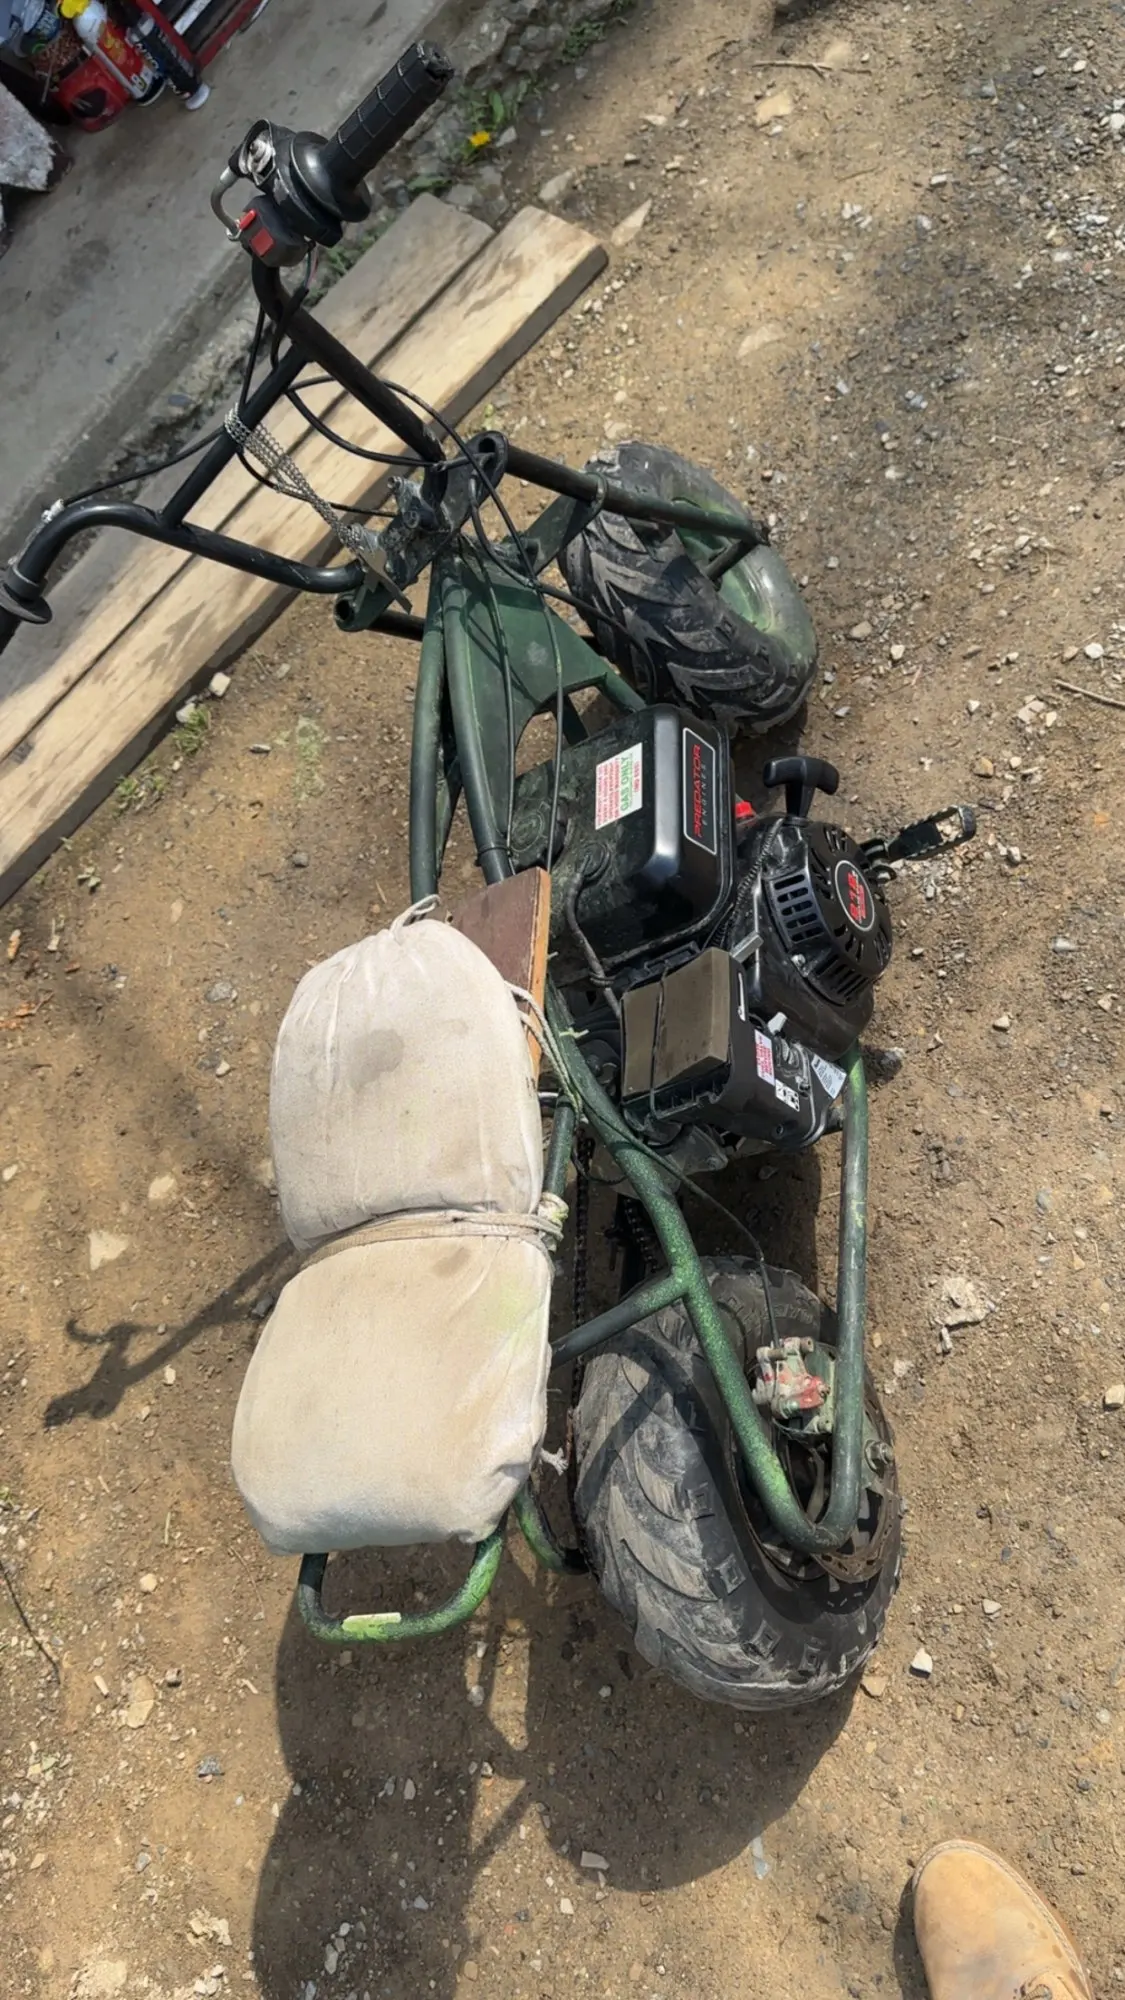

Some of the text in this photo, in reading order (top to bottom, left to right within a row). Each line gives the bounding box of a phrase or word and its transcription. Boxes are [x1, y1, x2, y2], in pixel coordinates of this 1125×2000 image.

[621, 757, 630, 812] GAS ONLY
[692, 744, 702, 838] PREDATOR
